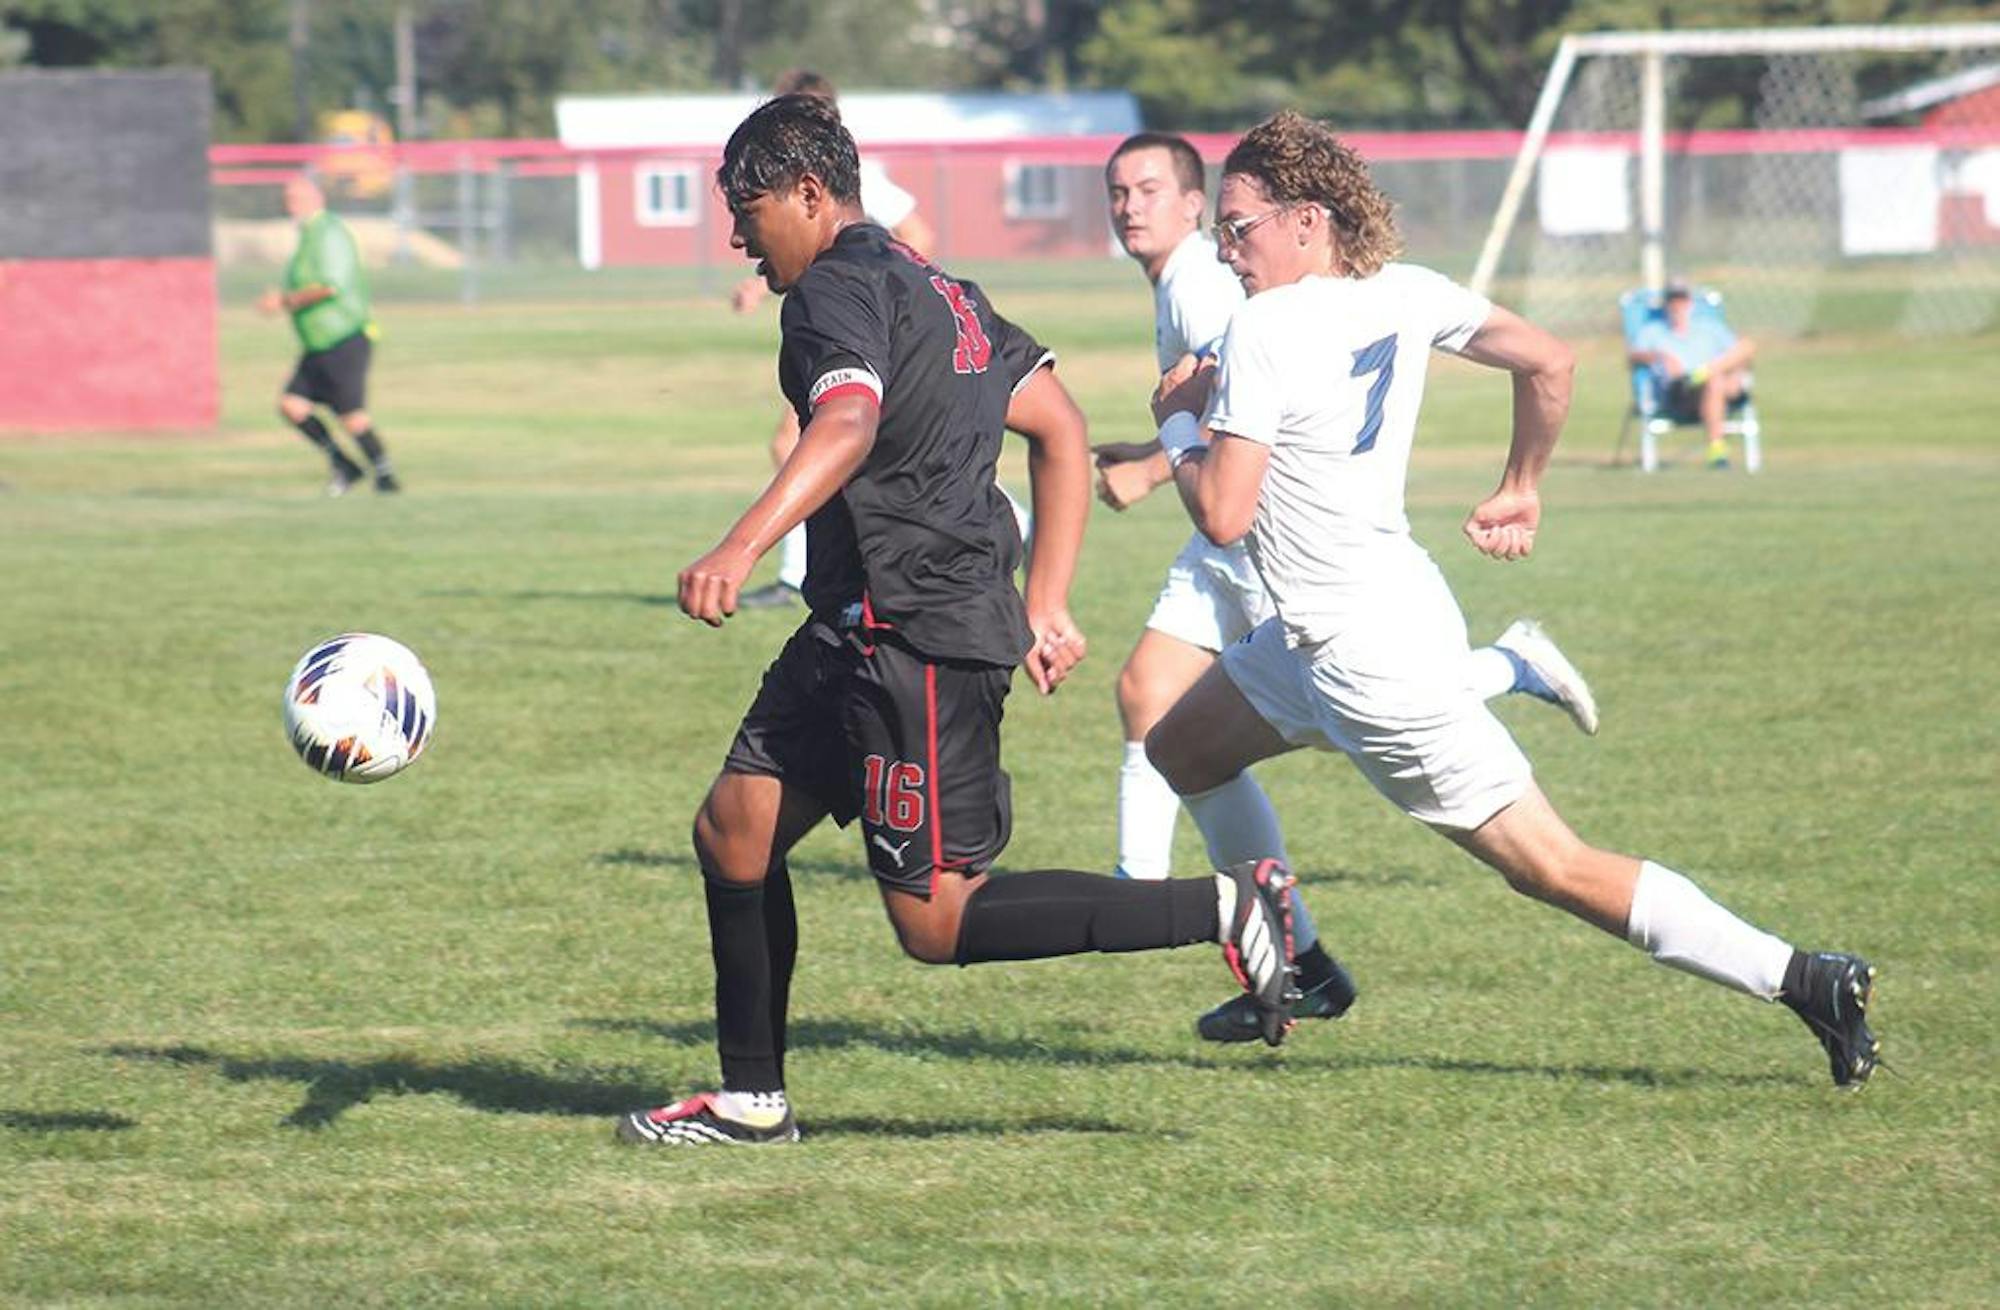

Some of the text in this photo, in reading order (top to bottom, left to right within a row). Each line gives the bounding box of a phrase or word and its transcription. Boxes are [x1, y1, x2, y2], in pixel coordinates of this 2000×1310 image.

[812, 372, 852, 396] APTAIN
[1350, 332, 1399, 456] 7
[864, 754, 925, 833] 16
